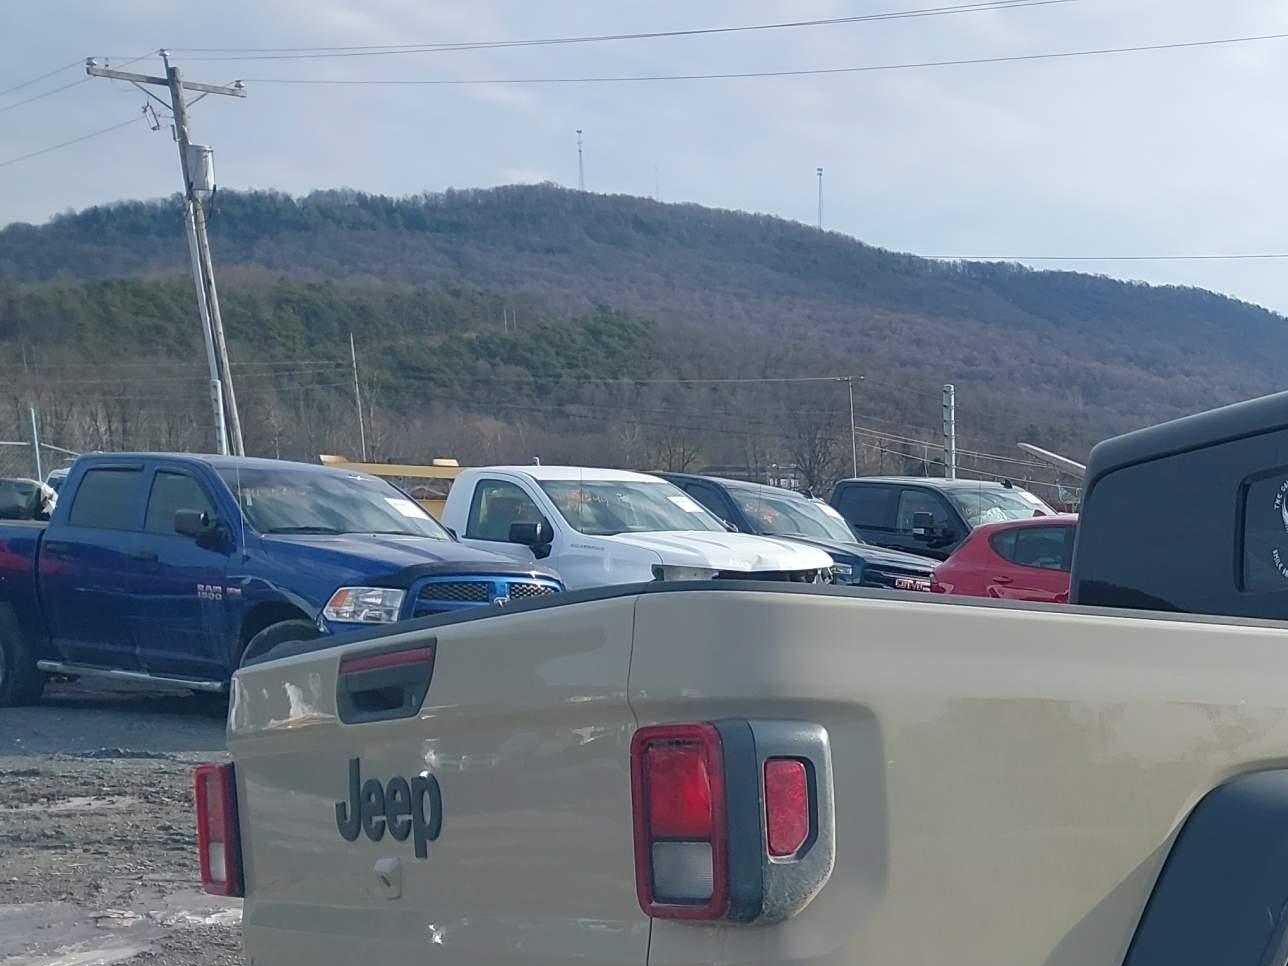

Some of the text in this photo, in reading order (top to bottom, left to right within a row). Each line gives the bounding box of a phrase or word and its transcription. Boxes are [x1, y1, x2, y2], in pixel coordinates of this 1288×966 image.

[197, 584, 222, 592] RAM
[895, 578, 931, 592] GMC
[197, 591, 222, 600] 1500
[335, 757, 443, 859] Jeep
